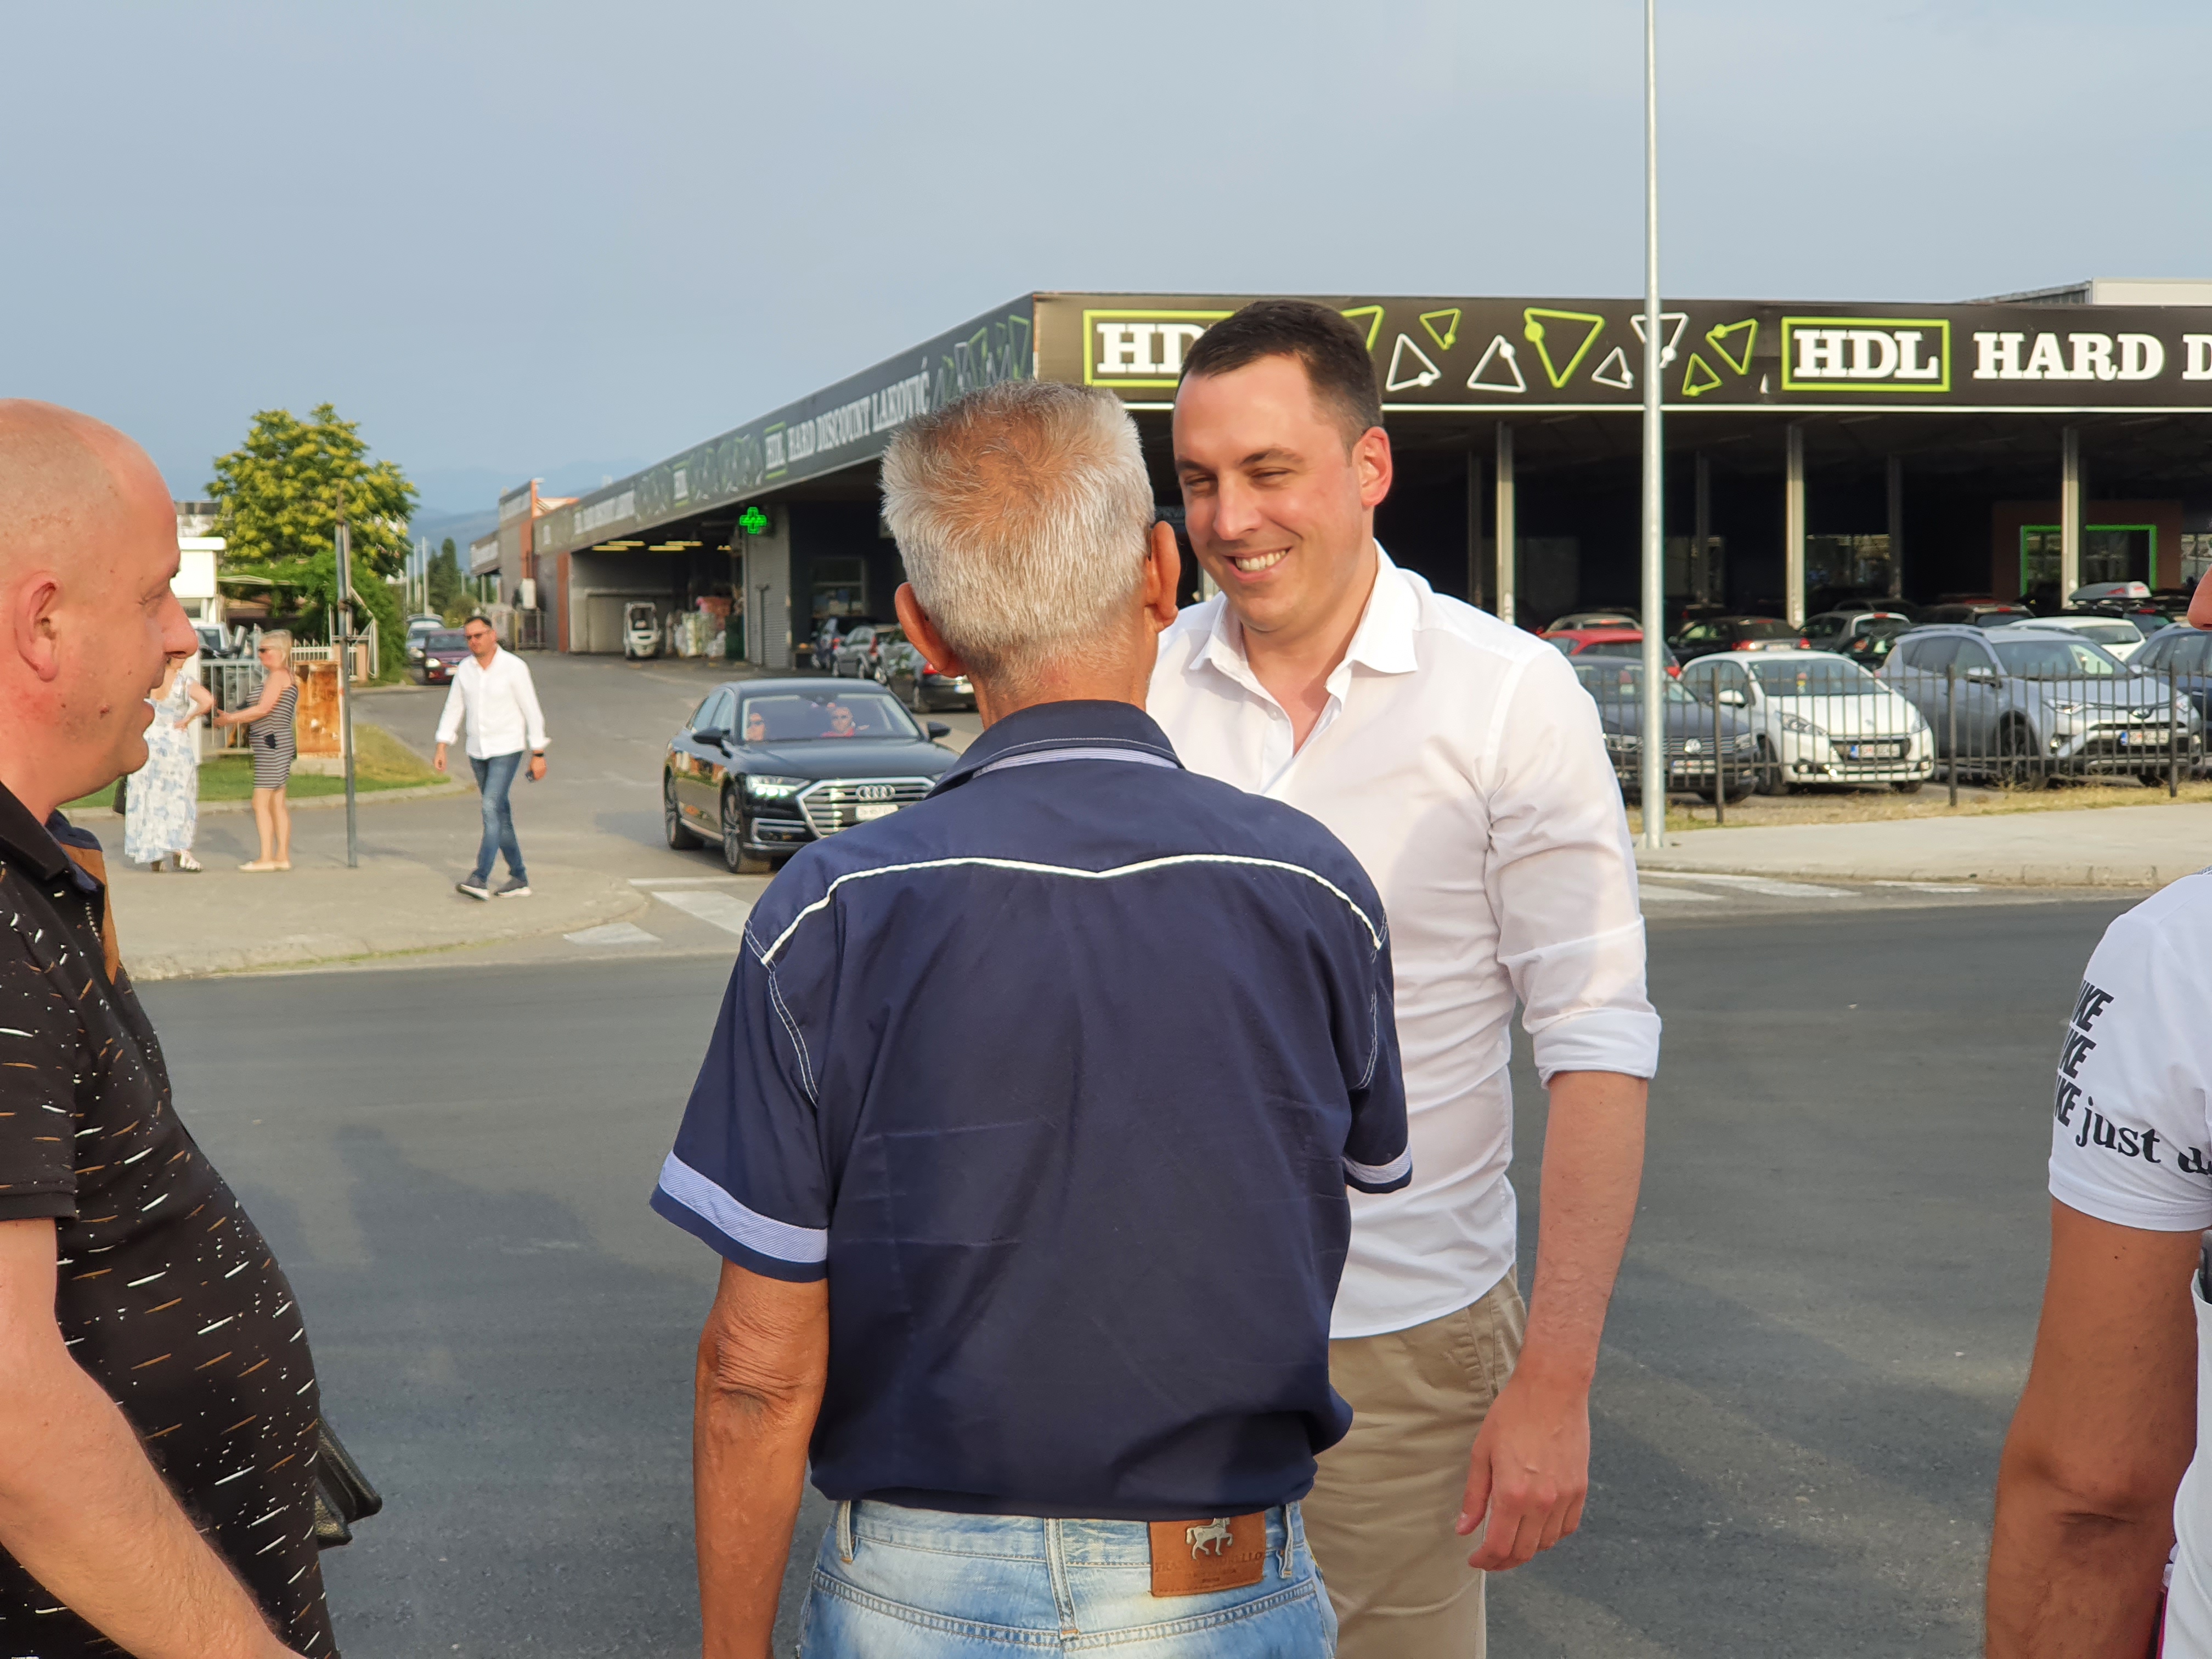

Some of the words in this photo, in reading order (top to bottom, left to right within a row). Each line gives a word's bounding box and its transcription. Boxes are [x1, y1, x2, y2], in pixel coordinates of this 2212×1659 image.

[1793, 330, 1939, 379] HDL
[1973, 332, 2165, 381] HARD
[2075, 1096, 2162, 1164] just
